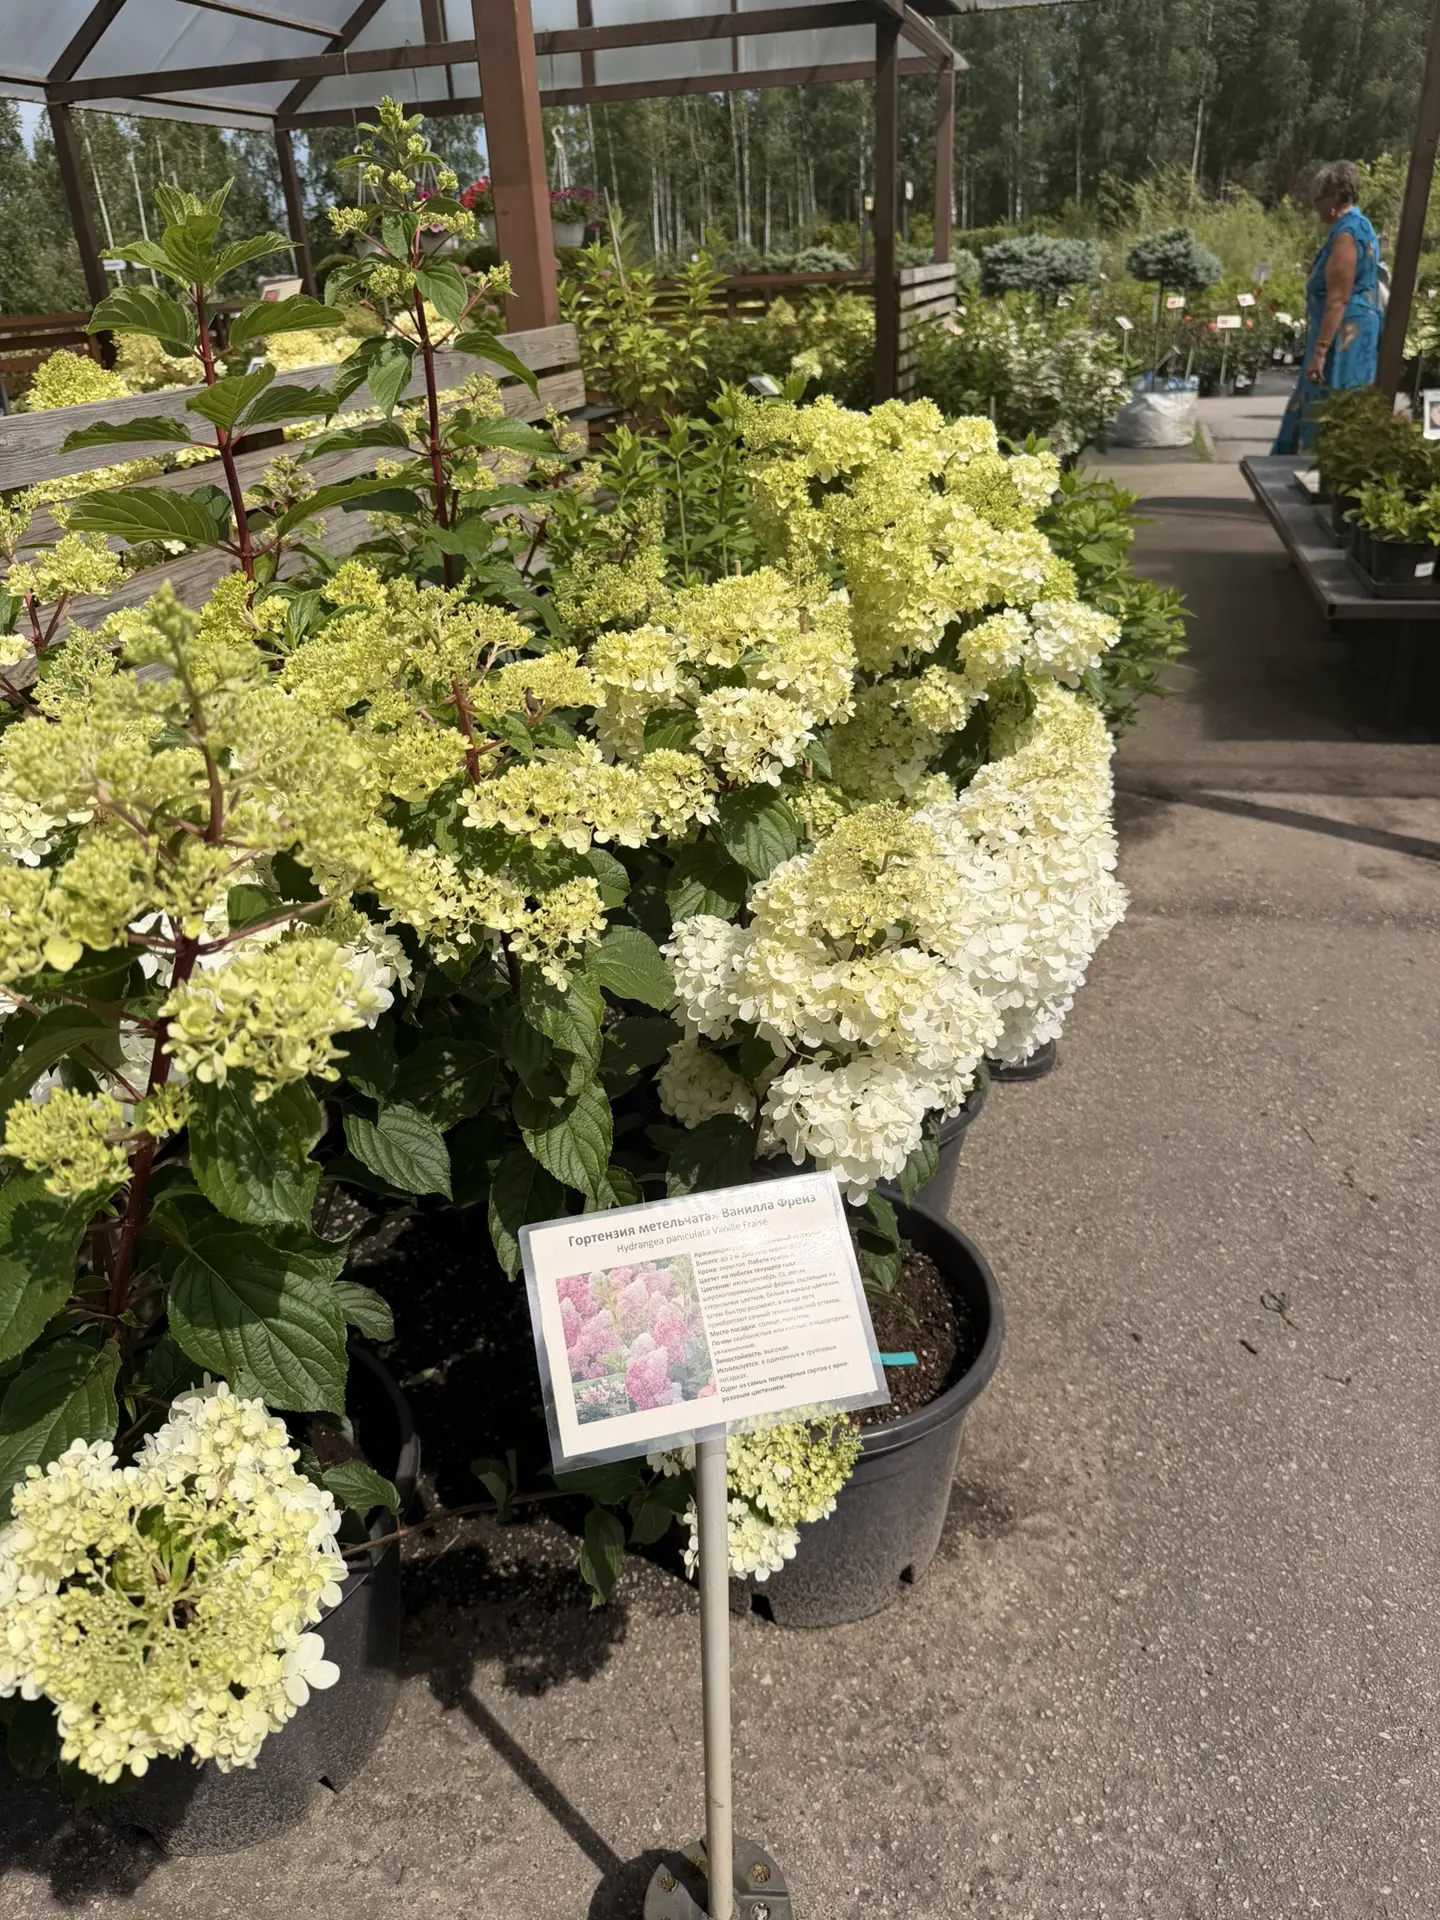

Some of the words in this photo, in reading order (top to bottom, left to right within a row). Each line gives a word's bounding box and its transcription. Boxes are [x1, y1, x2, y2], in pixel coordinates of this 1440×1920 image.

[568, 1226, 636, 1247] Гортензия
[720, 1201, 775, 1218] Ванилла
[616, 1237, 665, 1254] Hydrangea
[665, 1228, 711, 1245] paniculata
[742, 1218, 768, 1231] Fraise
[720, 1384, 738, 1393] Один
[721, 1391, 750, 1404] розовым
